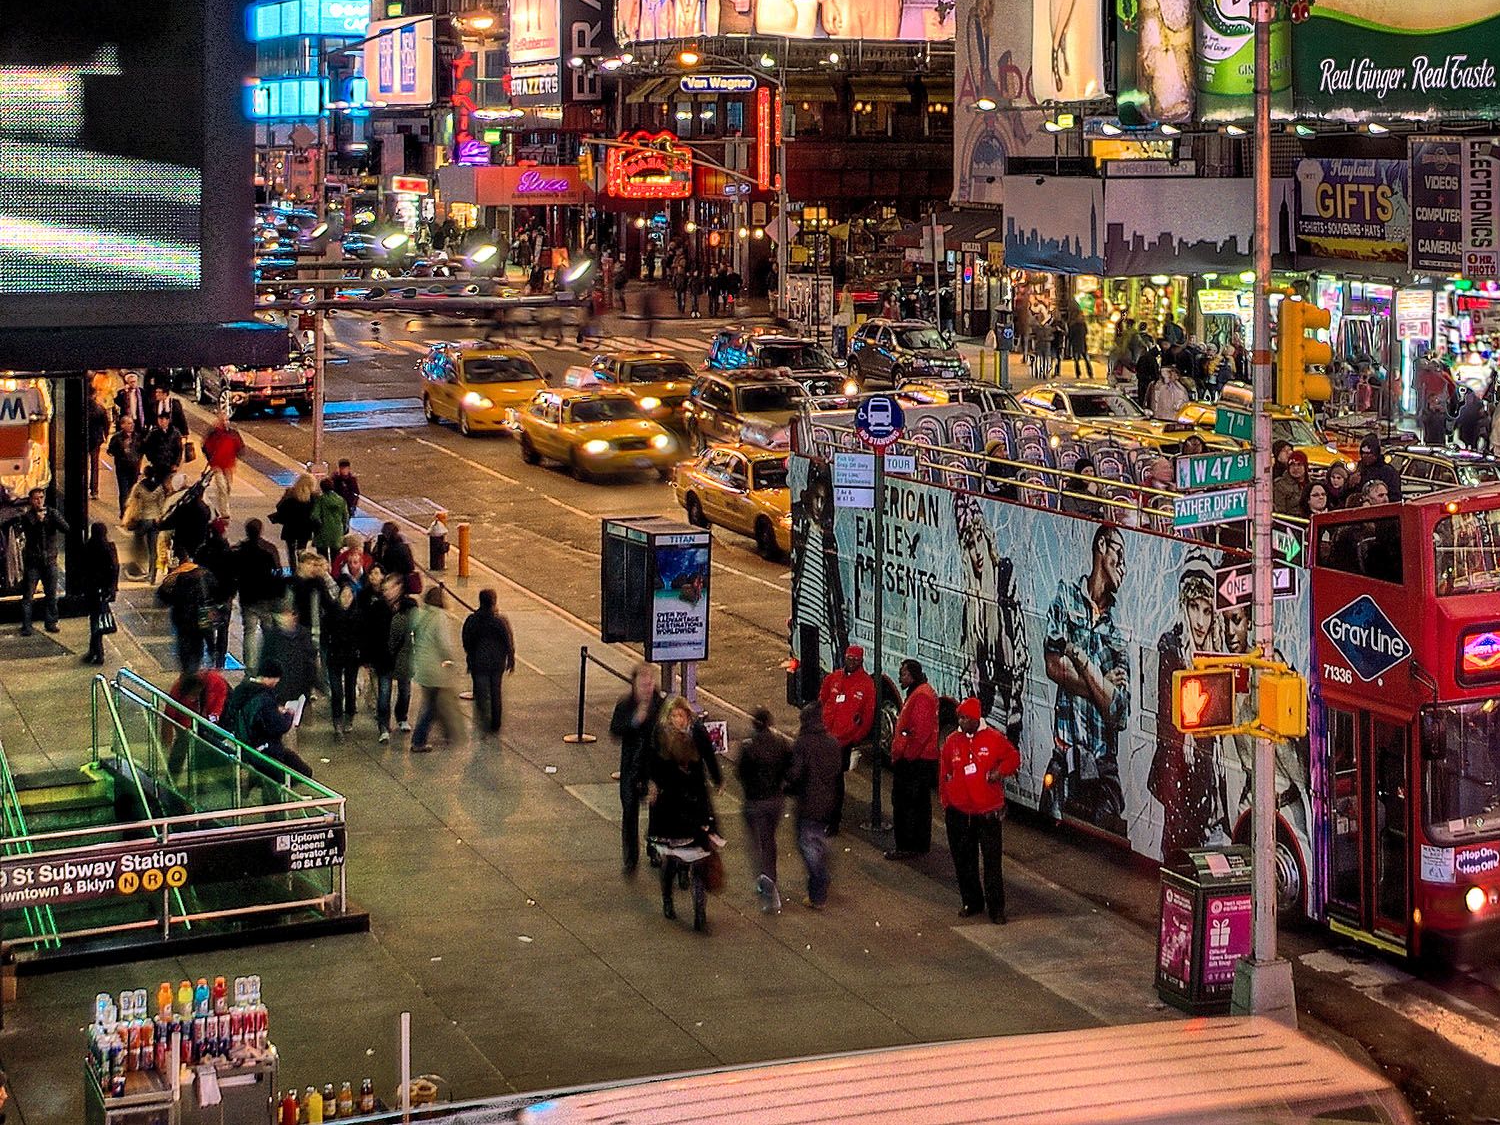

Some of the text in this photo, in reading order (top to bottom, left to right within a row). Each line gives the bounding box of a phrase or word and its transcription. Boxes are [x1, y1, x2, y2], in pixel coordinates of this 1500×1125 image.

[1319, 53, 1497, 99] Real Ginger. Real Taste.
[511, 76, 558, 96] BRAZZERS
[1424, 174, 1459, 191] VIDEOS
[1315, 181, 1394, 223] GIFTS
[1470, 140, 1493, 249] ELECTRONICS
[1467, 265, 1496, 276] PHOTO
[1226, 411, 1235, 433] 7
[859, 429, 900, 446] NO STANDING
[886, 458, 911, 470] TOUR
[1193, 453, 1250, 484] W 47 ST
[1174, 492, 1247, 518] FATHER DUFFY
[670, 535, 696, 544] TITAN
[1277, 535, 1295, 553] WAY
[1226, 577, 1247, 596] ONE
[1323, 664, 1353, 684] 71336
[290, 833, 326, 844] Uptown
[290, 840, 325, 852] Queens
[290, 848, 328, 861] elevator
[331, 855, 344, 865] Av
[12, 849, 188, 885] St Subway Station
[62, 876, 115, 896] & Bklyn
